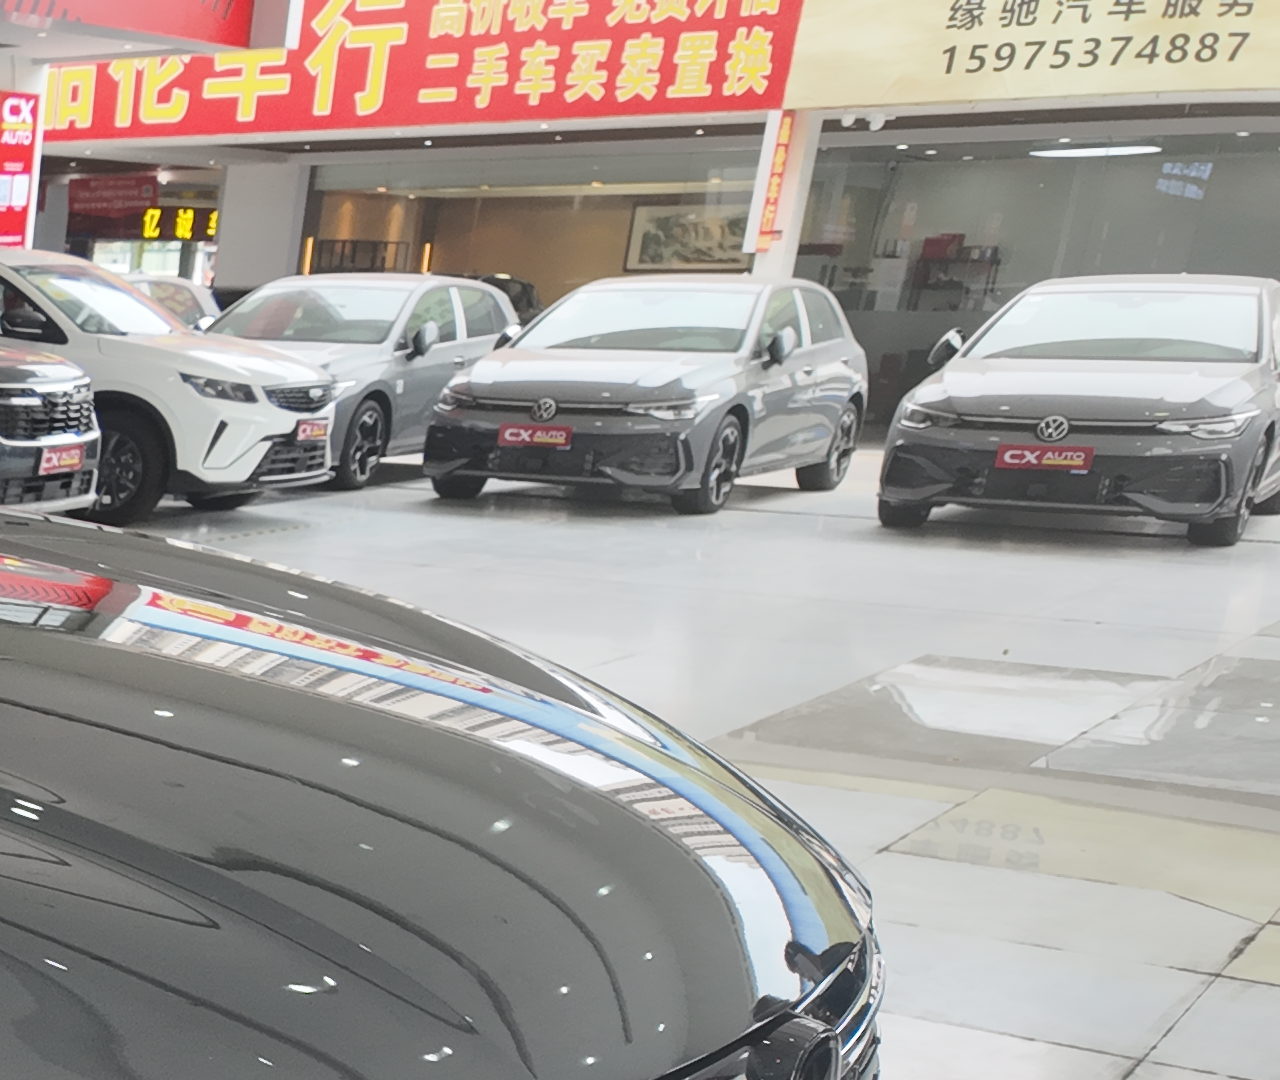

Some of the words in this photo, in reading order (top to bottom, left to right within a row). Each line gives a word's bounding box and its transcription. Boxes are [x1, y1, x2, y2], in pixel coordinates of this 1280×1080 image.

[941, 32, 1250, 74] 15975374887
[417, 26, 774, 108] 二手车买卖置换
[1, 97, 35, 124] CX
[0, 130, 33, 146] AUTO
[504, 428, 532, 442] CX
[534, 430, 567, 440] AUTO
[1003, 449, 1041, 464] CX
[1043, 451, 1085, 461] AUTO
